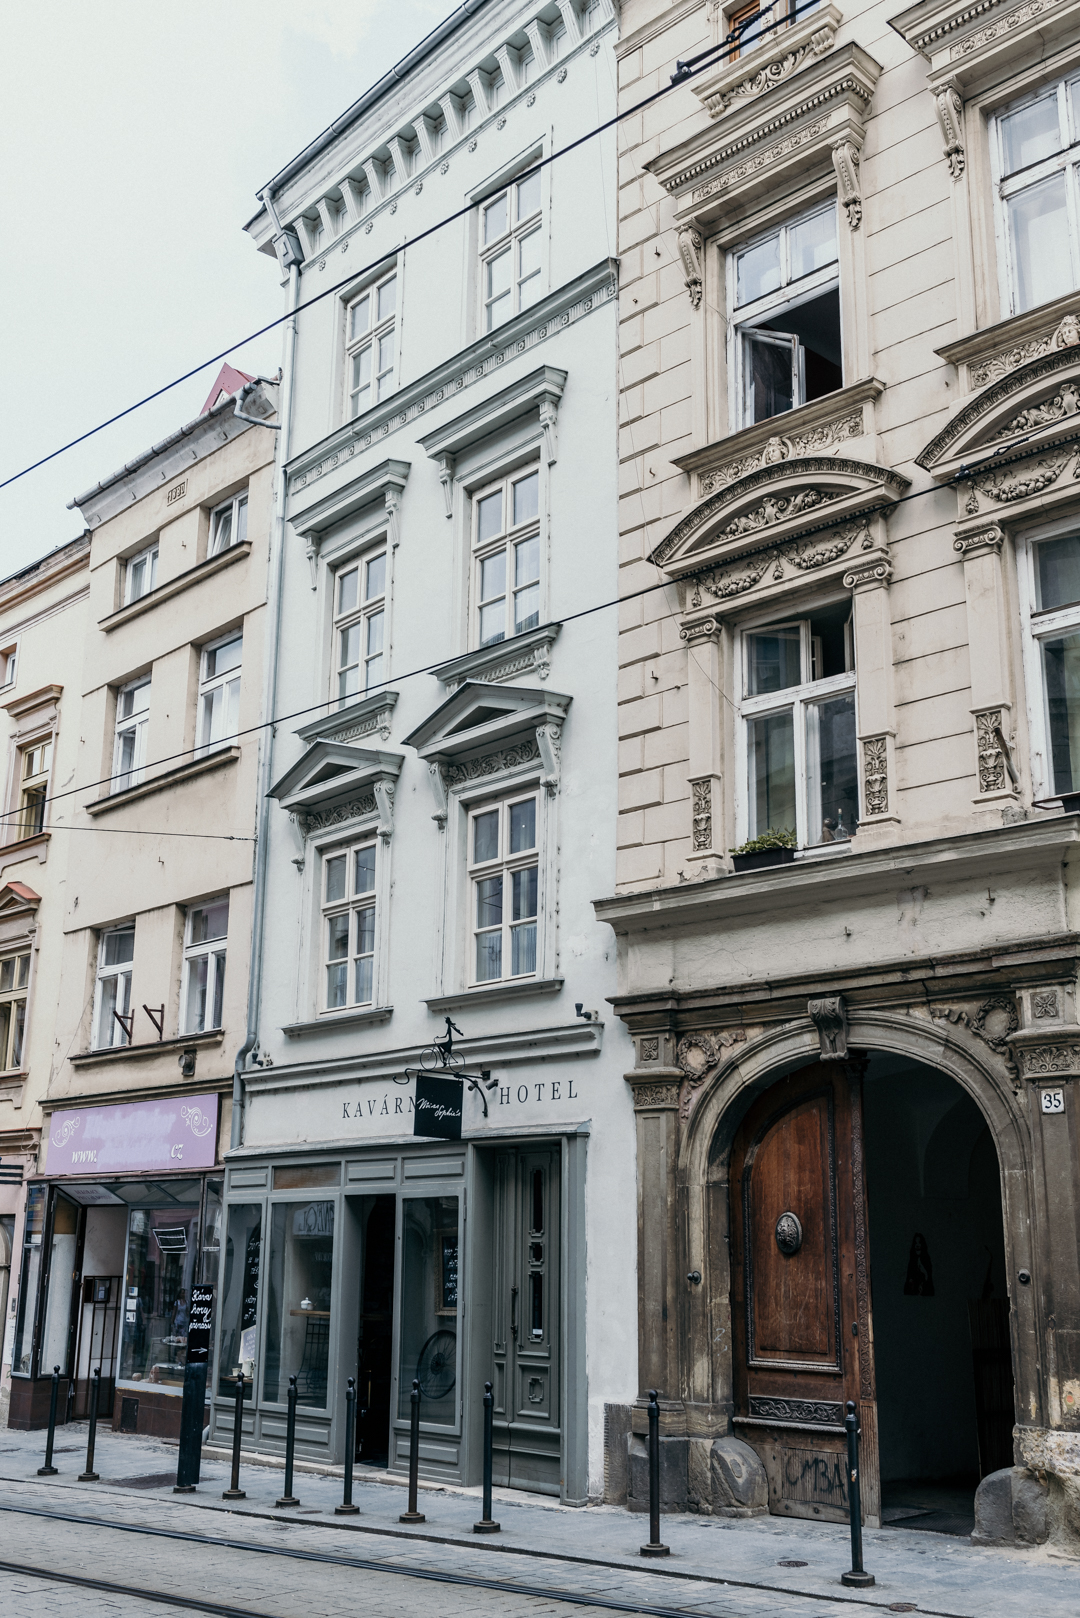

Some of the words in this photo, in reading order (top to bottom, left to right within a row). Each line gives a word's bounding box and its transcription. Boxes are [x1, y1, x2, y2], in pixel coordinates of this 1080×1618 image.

[500, 1080, 578, 1105] HOTEL
[1043, 1092, 1062, 1109] 35
[342, 1094, 417, 1119] KAVÁRN
[417, 1098, 440, 1110] Miss
[434, 1105, 461, 1121] Sophie's
[71, 1149, 98, 1164] www.
